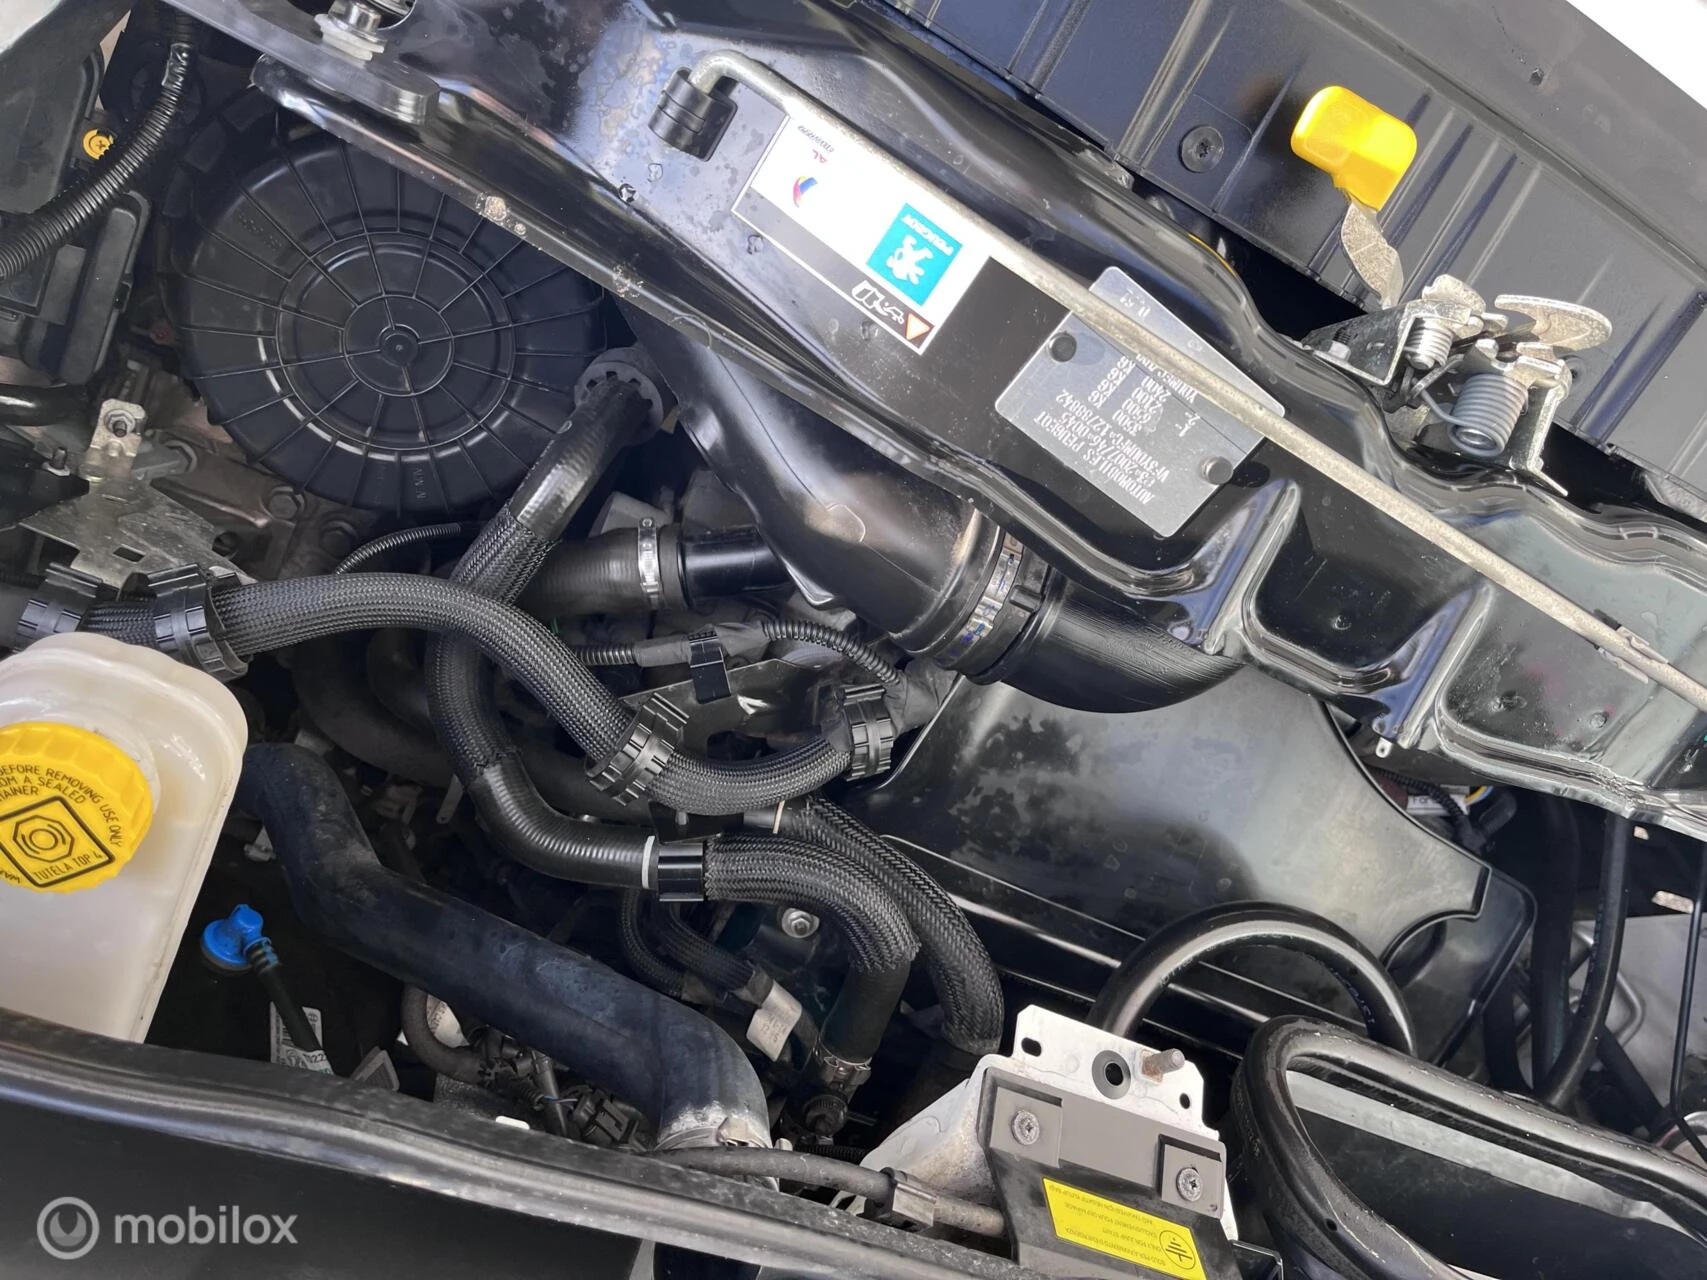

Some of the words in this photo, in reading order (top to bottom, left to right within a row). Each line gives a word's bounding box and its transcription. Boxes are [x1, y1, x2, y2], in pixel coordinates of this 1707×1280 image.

[1106, 366, 1126, 384] KG
[1116, 355, 1136, 373] KG
[1087, 389, 1106, 407] KG
[1096, 378, 1116, 396] KG
[1130, 386, 1162, 413] 2100
[1140, 374, 1171, 402] 2400
[1111, 408, 1142, 435] 3500
[1120, 397, 1151, 424] 6500
[1033, 409, 1085, 451] PEUGEOT
[1082, 447, 1154, 504] AUTOMOBILES
[23, 775, 32, 784] A
[38, 776, 86, 805] SEALED
[45, 767, 104, 804] REMOVING
[99, 804, 118, 823] USE
[109, 824, 122, 848] ONLY
[33, 862, 73, 881] TUTELA
[72, 854, 90, 866] TOP
[94, 850, 103, 860] 4
